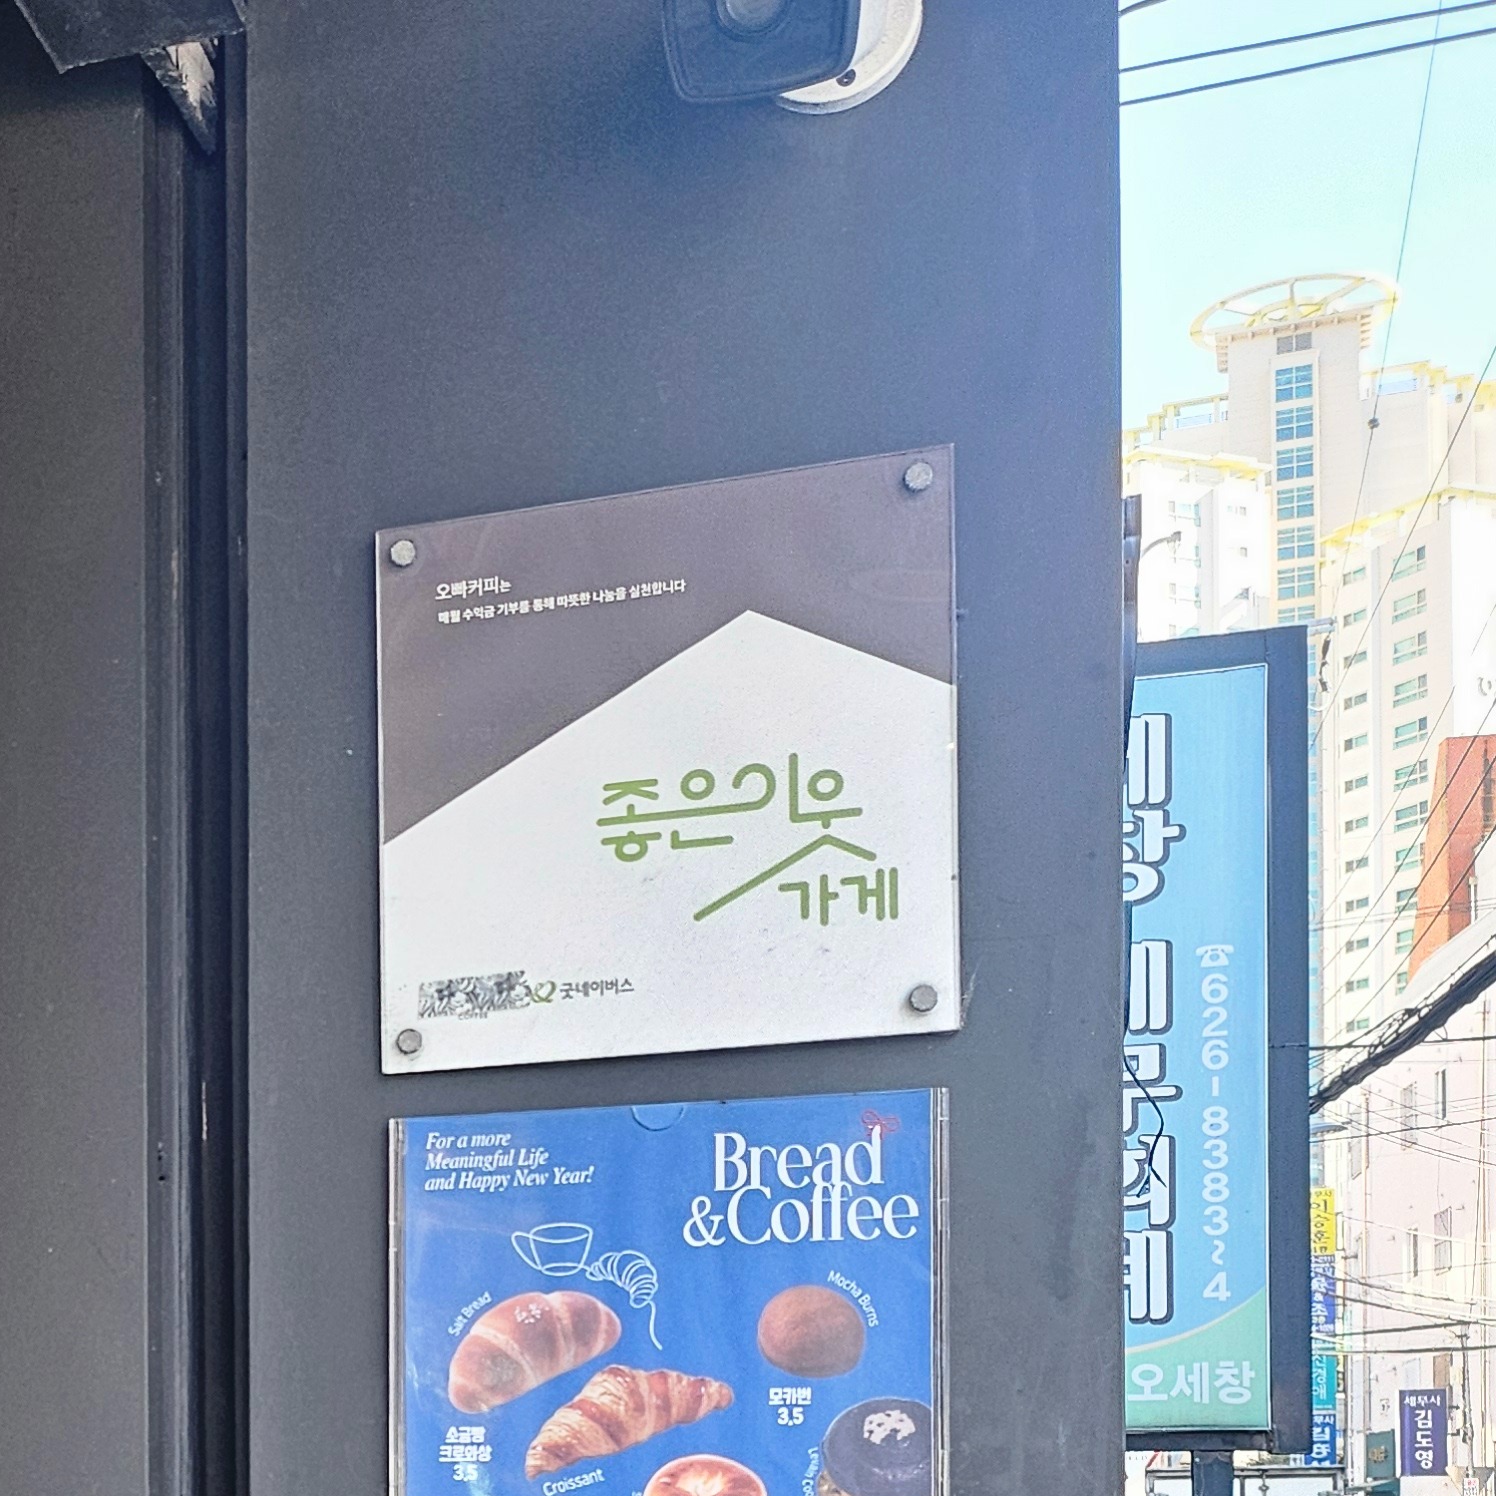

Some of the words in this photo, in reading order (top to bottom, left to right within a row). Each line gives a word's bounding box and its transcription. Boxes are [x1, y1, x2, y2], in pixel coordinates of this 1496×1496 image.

[435, 575, 512, 601] 오빠커피는
[461, 604, 496, 621] 수익금
[496, 599, 531, 617] 기부를
[556, 592, 591, 610] 따뜻한
[778, 867, 899, 926] 가게
[559, 977, 635, 1000] 굿네이버스
[426, 1132, 454, 1150] For
[456, 1136, 468, 1149] a
[470, 1133, 512, 1149] more
[425, 1149, 515, 1172] Meaningful
[517, 1147, 550, 1170] Life
[713, 1124, 885, 1193] Bread
[424, 1171, 456, 1192] and
[458, 1170, 511, 1193] Happy
[512, 1168, 550, 1188] New
[552, 1165, 596, 1186] Year!
[683, 1181, 921, 1249] &Coffee
[826, 1269, 863, 1299] Mocha
[447, 1314, 468, 1338] Salt
[461, 1291, 492, 1323] Bread
[768, 1386, 812, 1406] 모카번
[1127, 1360, 1256, 1405] 오세창
[1404, 1394, 1441, 1408] 세무사
[777, 1407, 805, 1427] 3.5
[438, 1444, 493, 1463] 크로와상
[1414, 1409, 1434, 1470] 김도영
